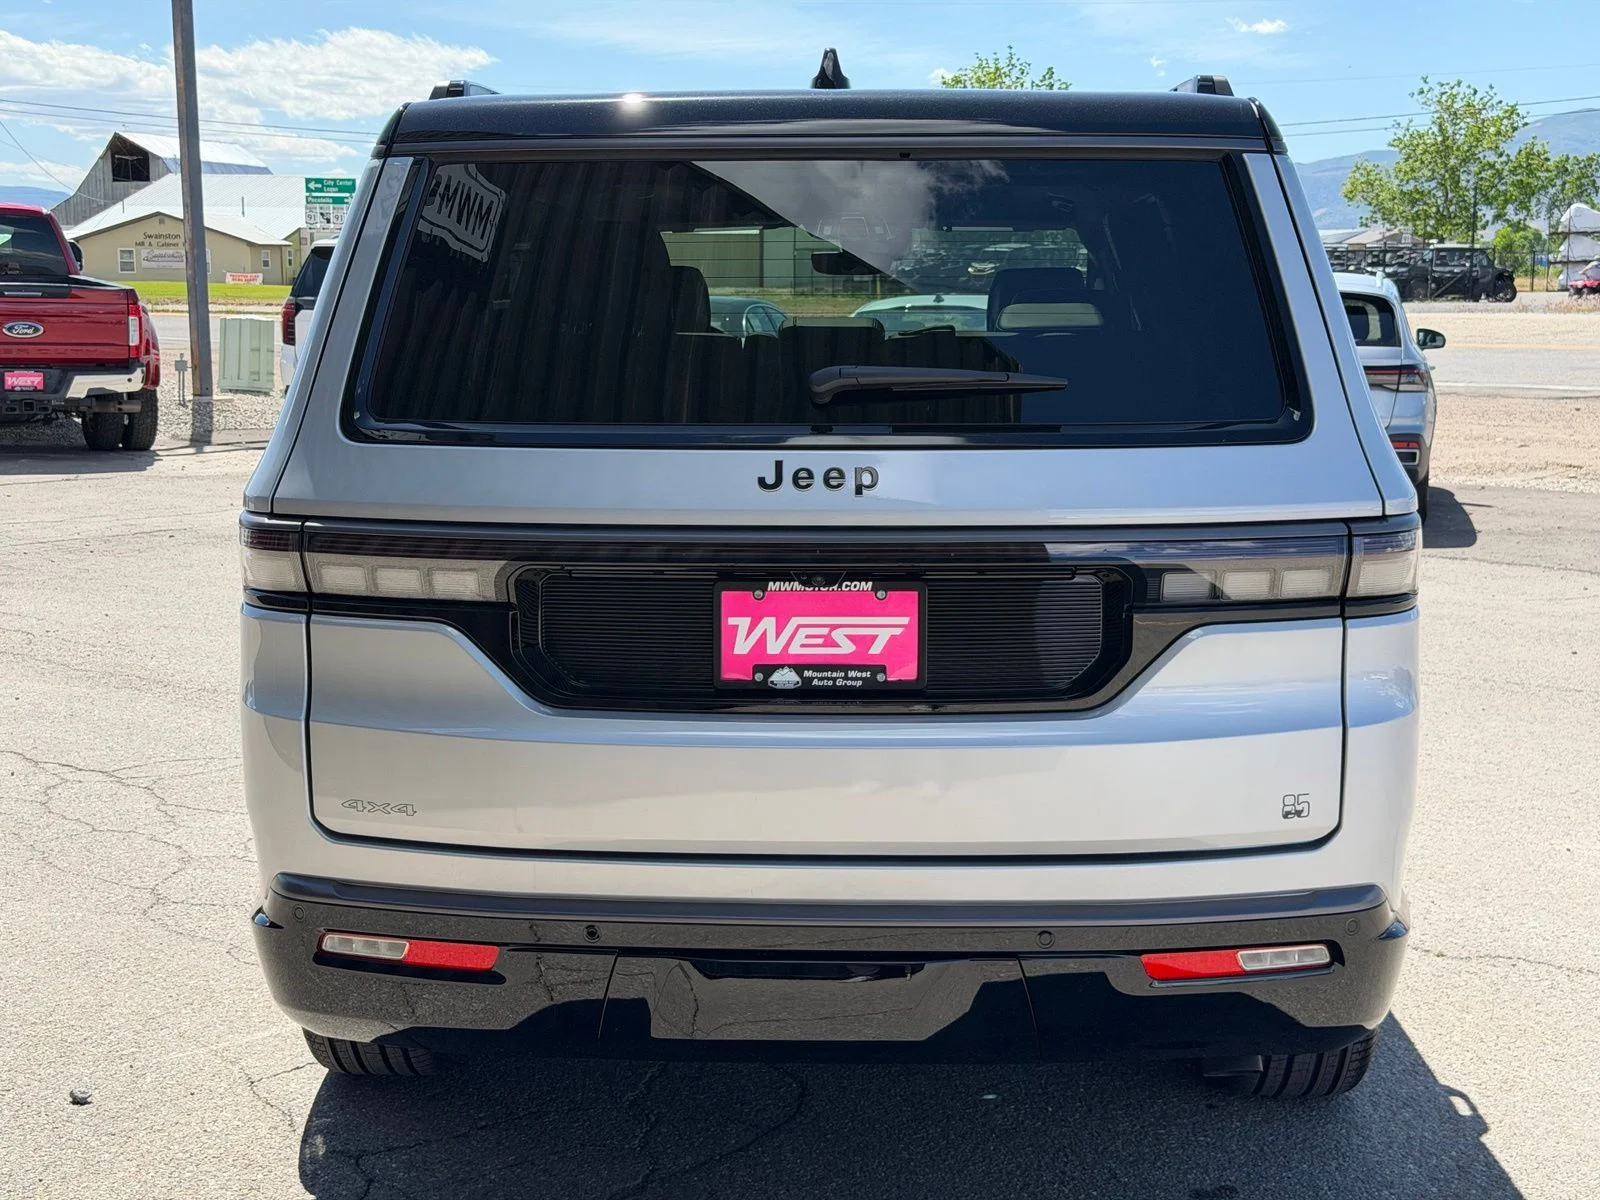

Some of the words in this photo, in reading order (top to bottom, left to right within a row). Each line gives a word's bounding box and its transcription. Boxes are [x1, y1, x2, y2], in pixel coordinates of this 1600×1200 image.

[143, 231, 181, 240] Swainston
[12, 324, 35, 334] Ford
[757, 459, 879, 497] Jeep
[727, 616, 911, 655] WEST
[803, 670, 845, 678] Mountain
[847, 670, 871, 678] West
[811, 678, 834, 687] Auto
[835, 678, 863, 688] Group
